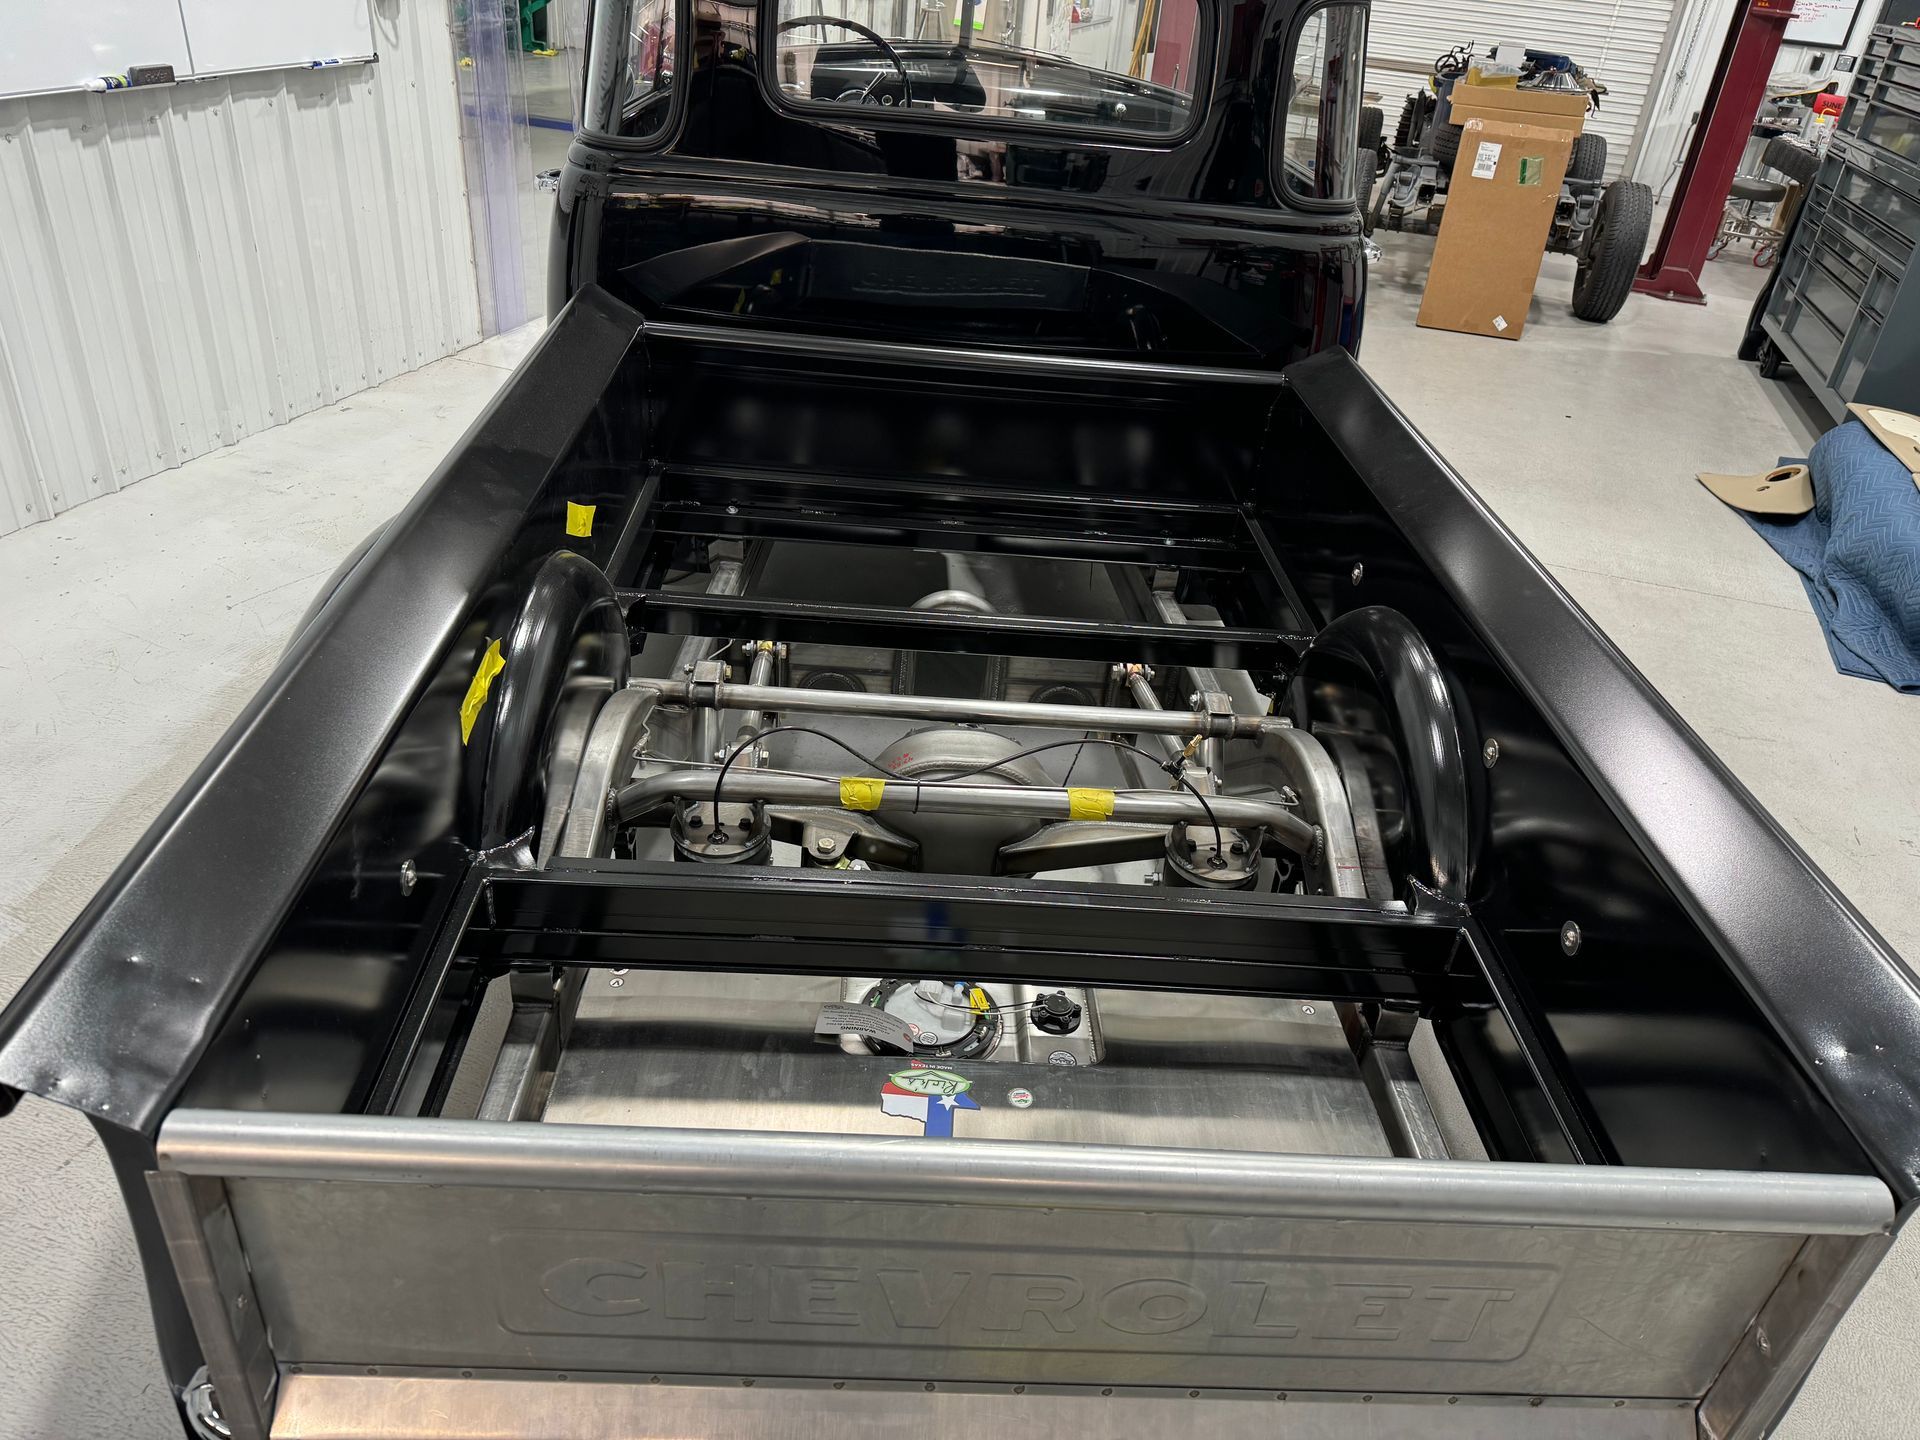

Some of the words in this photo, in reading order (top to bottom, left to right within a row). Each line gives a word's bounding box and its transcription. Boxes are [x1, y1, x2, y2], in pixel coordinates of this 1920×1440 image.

[840, 1026, 877, 1034] WARNING
[908, 1078, 958, 1094] Rick's
[540, 1257, 1517, 1343] CHEVROLET
